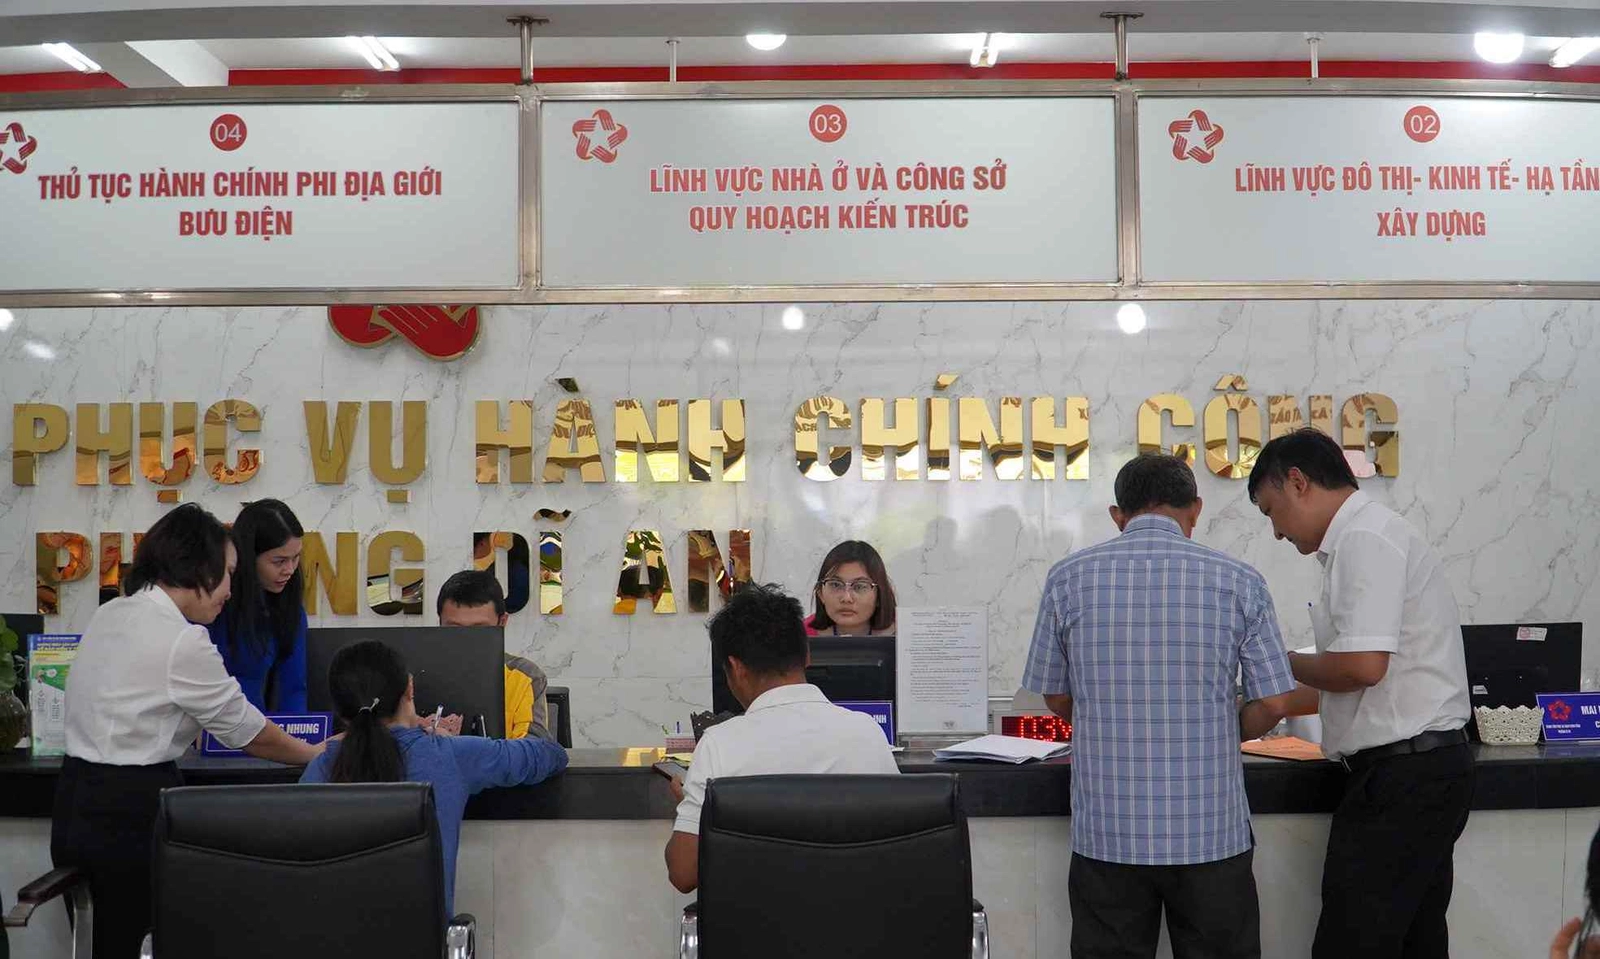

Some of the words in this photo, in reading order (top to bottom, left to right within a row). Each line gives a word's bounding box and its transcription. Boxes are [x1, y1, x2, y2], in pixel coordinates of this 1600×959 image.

[214, 123, 242, 143] 04
[815, 115, 843, 134] 03
[1410, 115, 1438, 135] 02
[38, 166, 82, 200] THỦ
[88, 172, 132, 203] TỤC
[139, 169, 206, 198] HÀNH
[213, 167, 288, 198] CHÍNH
[295, 170, 337, 197] PHI
[344, 170, 386, 202] ĐỊA
[393, 165, 442, 196] GIỚI
[649, 164, 707, 193] LĨNH
[715, 166, 764, 198] VỰC
[771, 163, 823, 192] NHÀ
[832, 158, 849, 191] Ở
[856, 162, 888, 192] VÀ
[896, 162, 965, 192] CÔNG
[974, 157, 1008, 191] SỞ
[1235, 163, 1286, 192] LĨNH
[1292, 164, 1336, 197] VỰC
[1342, 161, 1373, 192] ĐÔ
[1379, 166, 1422, 196] THỊ-
[1429, 166, 1481, 191] KINH
[1487, 158, 1519, 191] TẾ-
[1526, 166, 1555, 196] HẠ
[179, 208, 228, 237] BƯU
[235, 206, 293, 241] ĐIỆN
[689, 206, 737, 233] QUY
[745, 204, 830, 235] HOẠCH
[838, 197, 897, 229] KIẾN
[904, 200, 969, 229] TRÚC
[1377, 206, 1419, 237] XÂY
[1426, 210, 1487, 242] DỰNG
[12, 399, 265, 503] PHỤC
[303, 400, 429, 503] VỤ
[475, 377, 746, 483] HÀNH
[794, 373, 1091, 482] CHÍNH
[36, 528, 426, 616] PHNG
[472, 508, 572, 615] DĨ
[612, 529, 753, 615] AN
[286, 722, 320, 735] NHUNG
